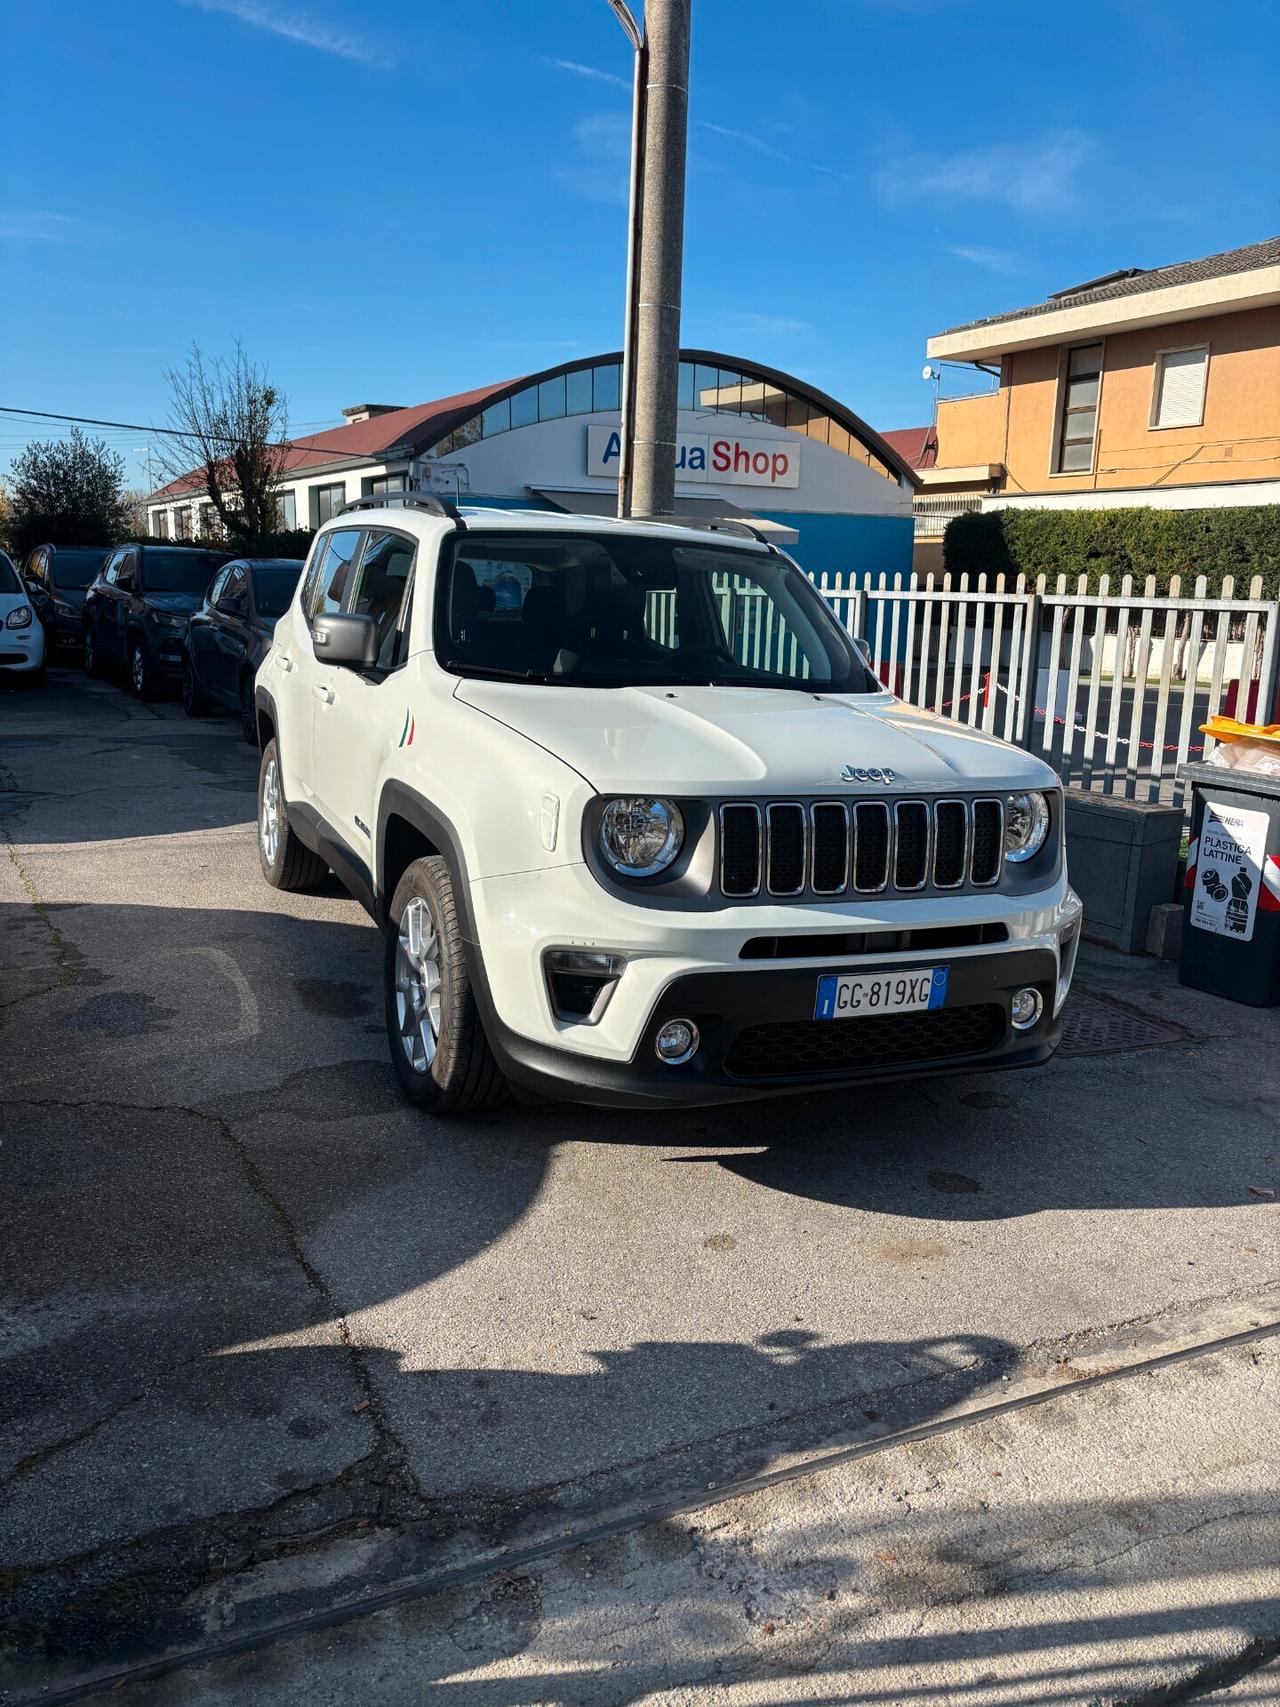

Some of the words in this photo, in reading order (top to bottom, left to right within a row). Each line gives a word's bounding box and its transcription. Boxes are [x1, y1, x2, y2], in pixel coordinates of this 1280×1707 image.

[602, 431, 706, 472] Aua
[711, 440, 789, 483] Shop
[840, 764, 896, 785] Jeep
[1203, 847, 1242, 865] LATTINE
[1205, 836, 1252, 856] PLASTICA
